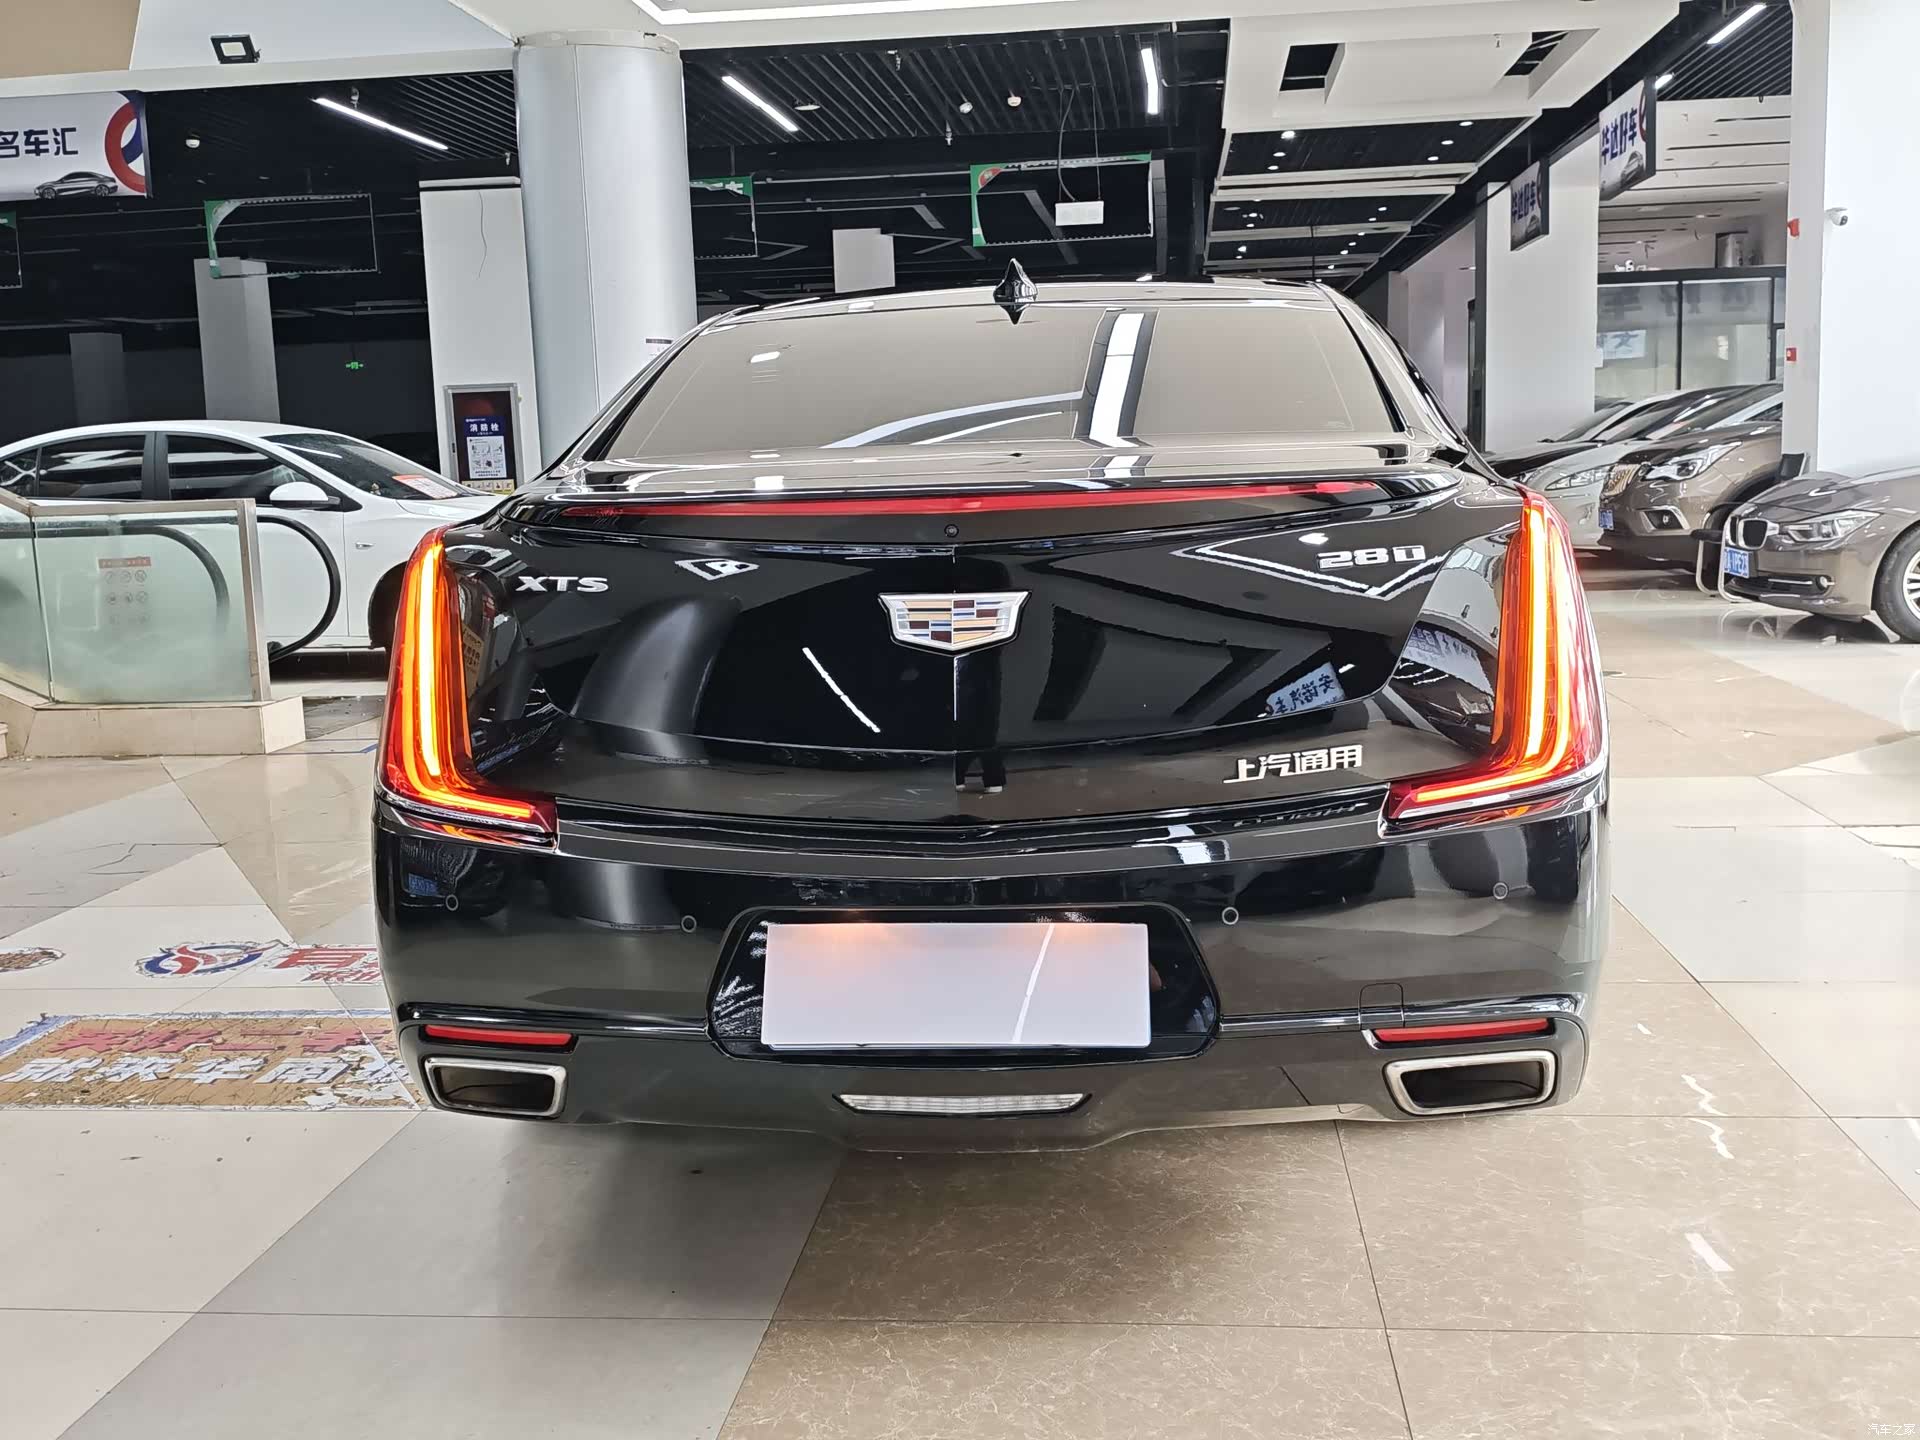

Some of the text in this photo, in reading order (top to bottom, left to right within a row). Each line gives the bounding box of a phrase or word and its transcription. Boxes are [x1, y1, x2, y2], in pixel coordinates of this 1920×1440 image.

[0, 127, 79, 159] 名车汇
[1601, 107, 1638, 166] 华达好车
[1317, 544, 1426, 570] 28T
[515, 576, 609, 592] XTS
[1223, 744, 1364, 784] 上汽通用
